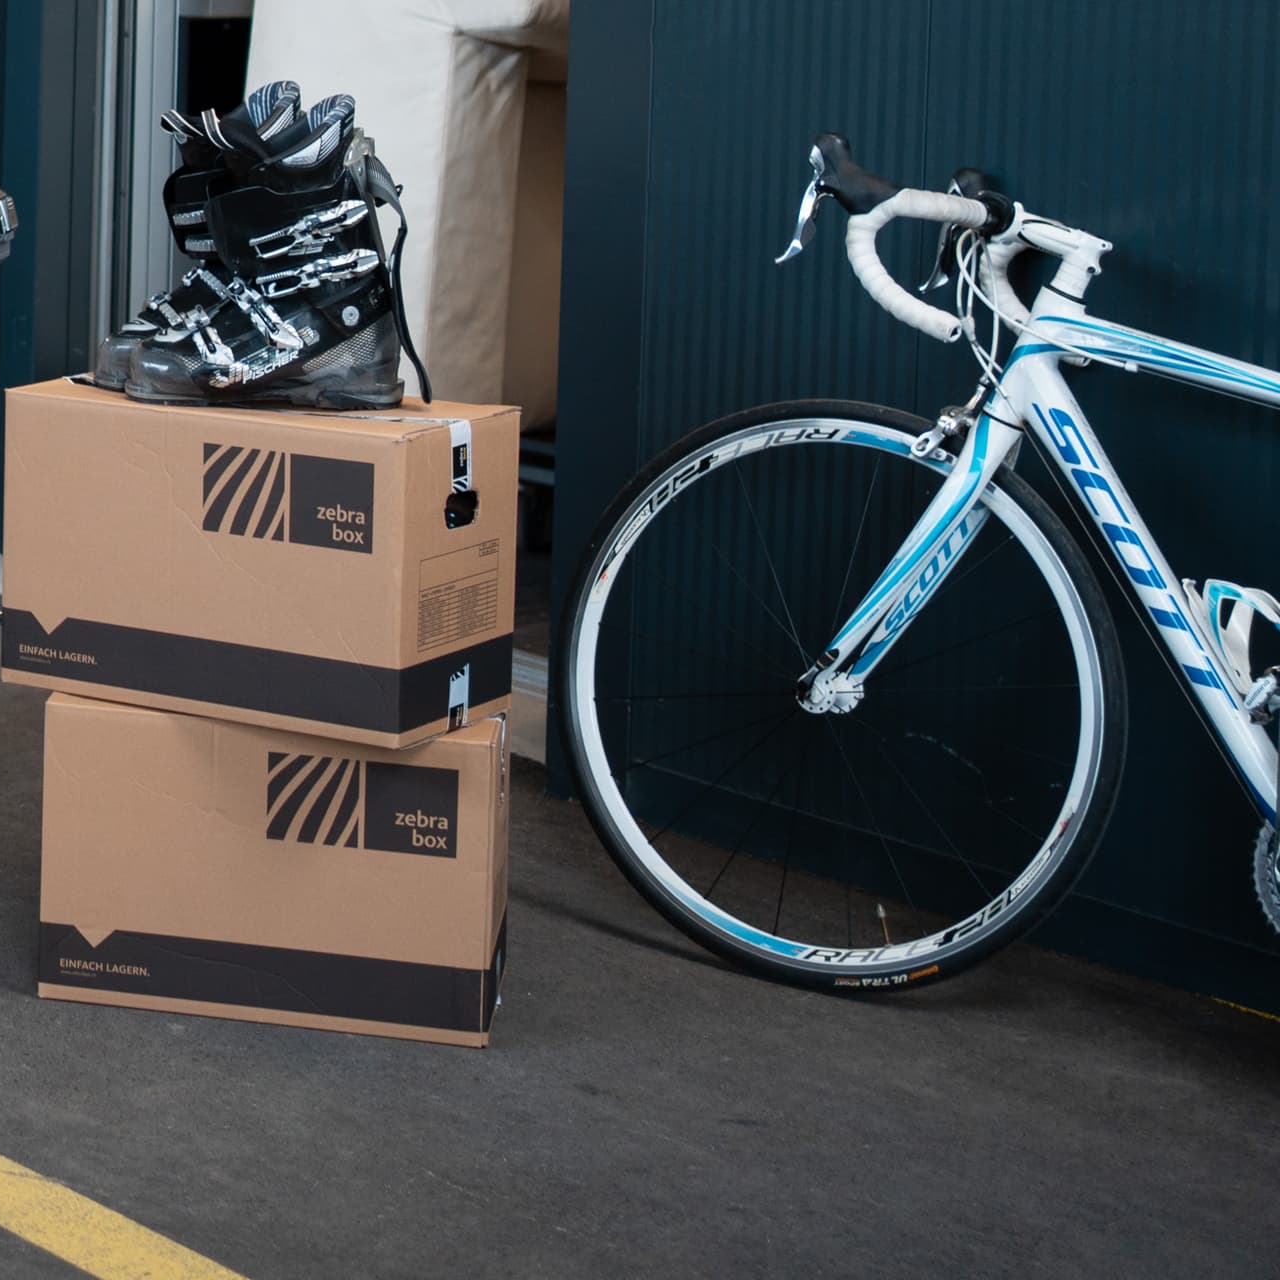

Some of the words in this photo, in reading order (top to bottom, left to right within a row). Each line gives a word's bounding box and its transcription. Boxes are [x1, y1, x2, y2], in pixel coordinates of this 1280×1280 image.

[316, 504, 366, 525] zebra
[332, 523, 364, 544] box
[1033, 403, 1240, 711] SCOTT
[885, 516, 970, 631] SCOTT
[19, 644, 57, 659] EINFACH
[59, 650, 98, 665] LAGERN.
[394, 809, 449, 830] zebra
[412, 829, 448, 849] box
[59, 958, 103, 972] EINFACH
[105, 963, 150, 977] LAGERN.
[860, 974, 908, 987] ULTRA
